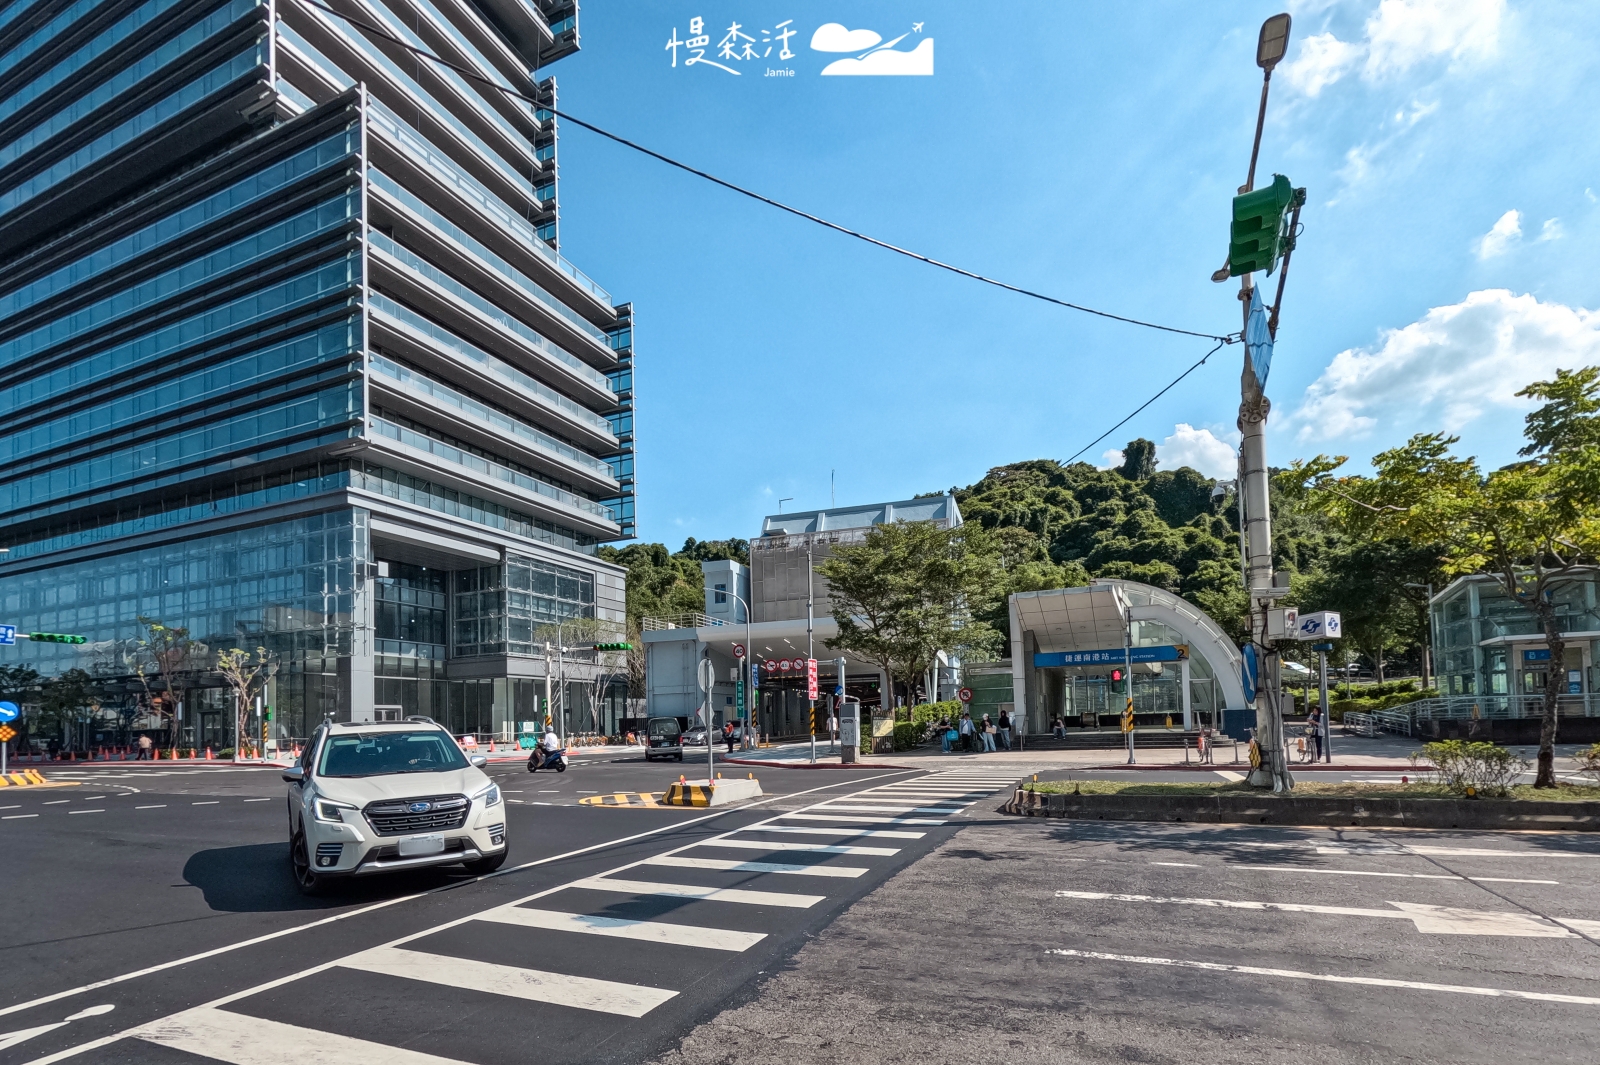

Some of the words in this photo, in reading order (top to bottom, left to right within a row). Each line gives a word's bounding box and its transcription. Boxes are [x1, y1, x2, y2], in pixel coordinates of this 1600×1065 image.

[1065, 652, 1110, 663] 捷運南港站
[1176, 648, 1185, 659] 2
